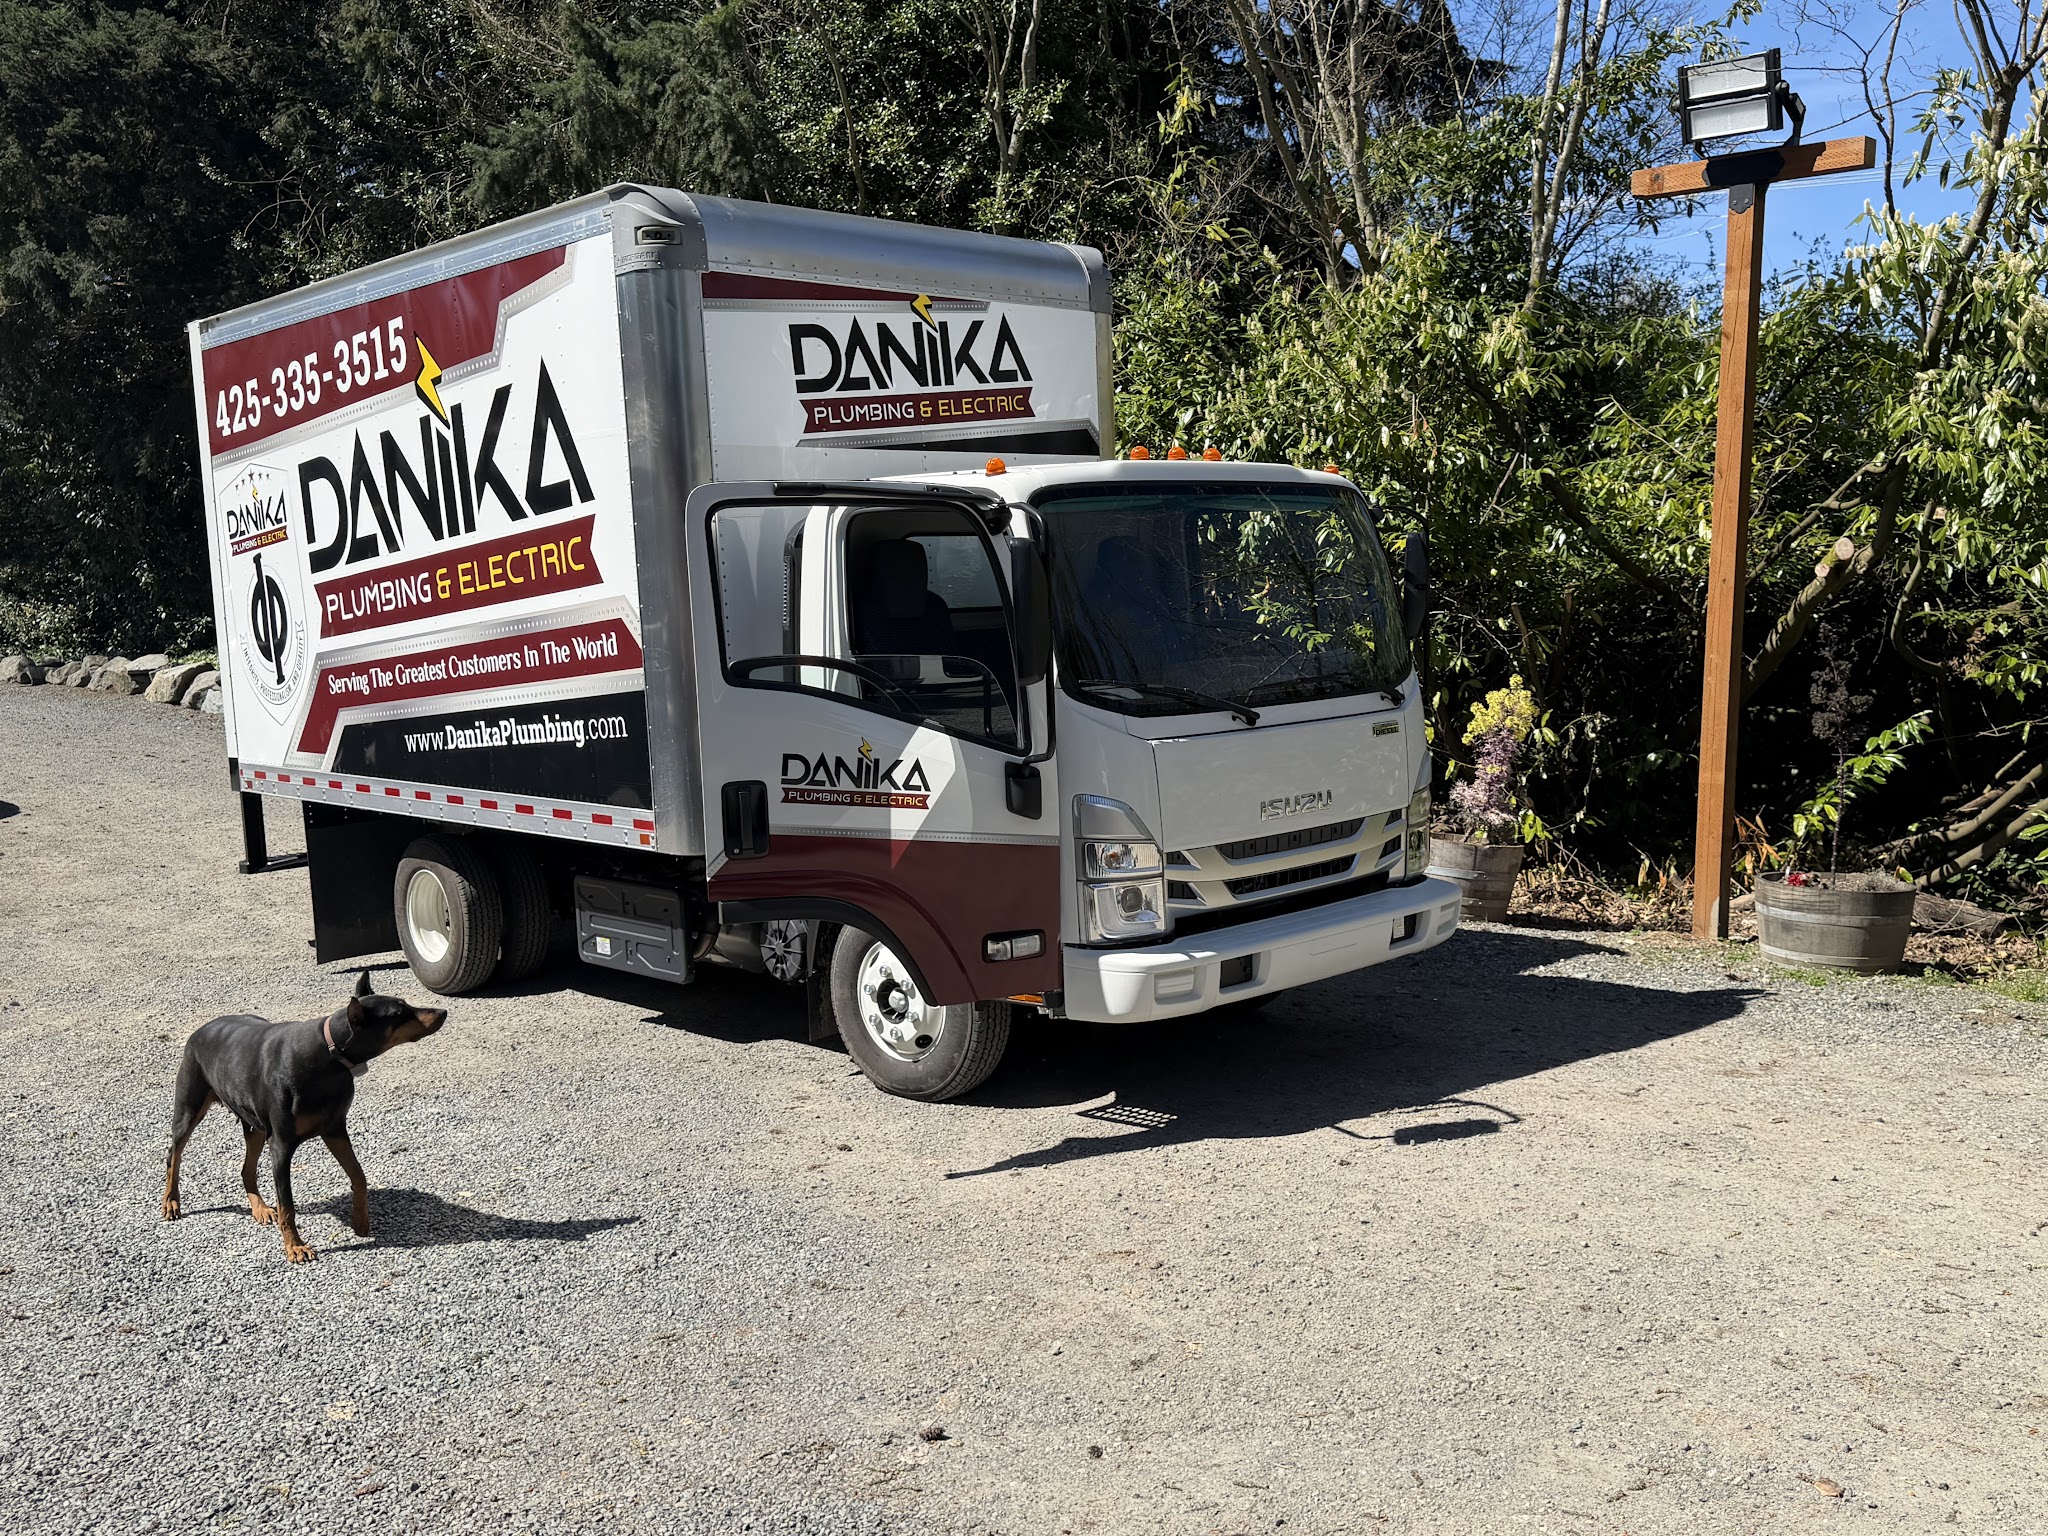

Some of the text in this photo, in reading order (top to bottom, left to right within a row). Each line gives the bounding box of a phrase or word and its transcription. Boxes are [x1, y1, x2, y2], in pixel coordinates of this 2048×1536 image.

[788, 313, 1033, 393] DANIKA
[216, 316, 407, 437] 425-335-3515
[814, 395, 1025, 424] PLUMBING & ELECTRIC
[298, 355, 595, 574] DANIKA
[226, 488, 287, 540] DANIKA
[233, 538, 257, 553] PLUMBING
[261, 529, 287, 544] ELECTRIC
[325, 536, 585, 623] PLUMBING & ELECTRIC
[328, 632, 618, 695] Serving The Greatest Customers In The World
[404, 714, 629, 752] www.DanikaPlumbing.com
[781, 752, 931, 792] DANIKA
[788, 791, 924, 806] PLUMBING & ELECTRIC
[1261, 790, 1332, 822] ISUZU
